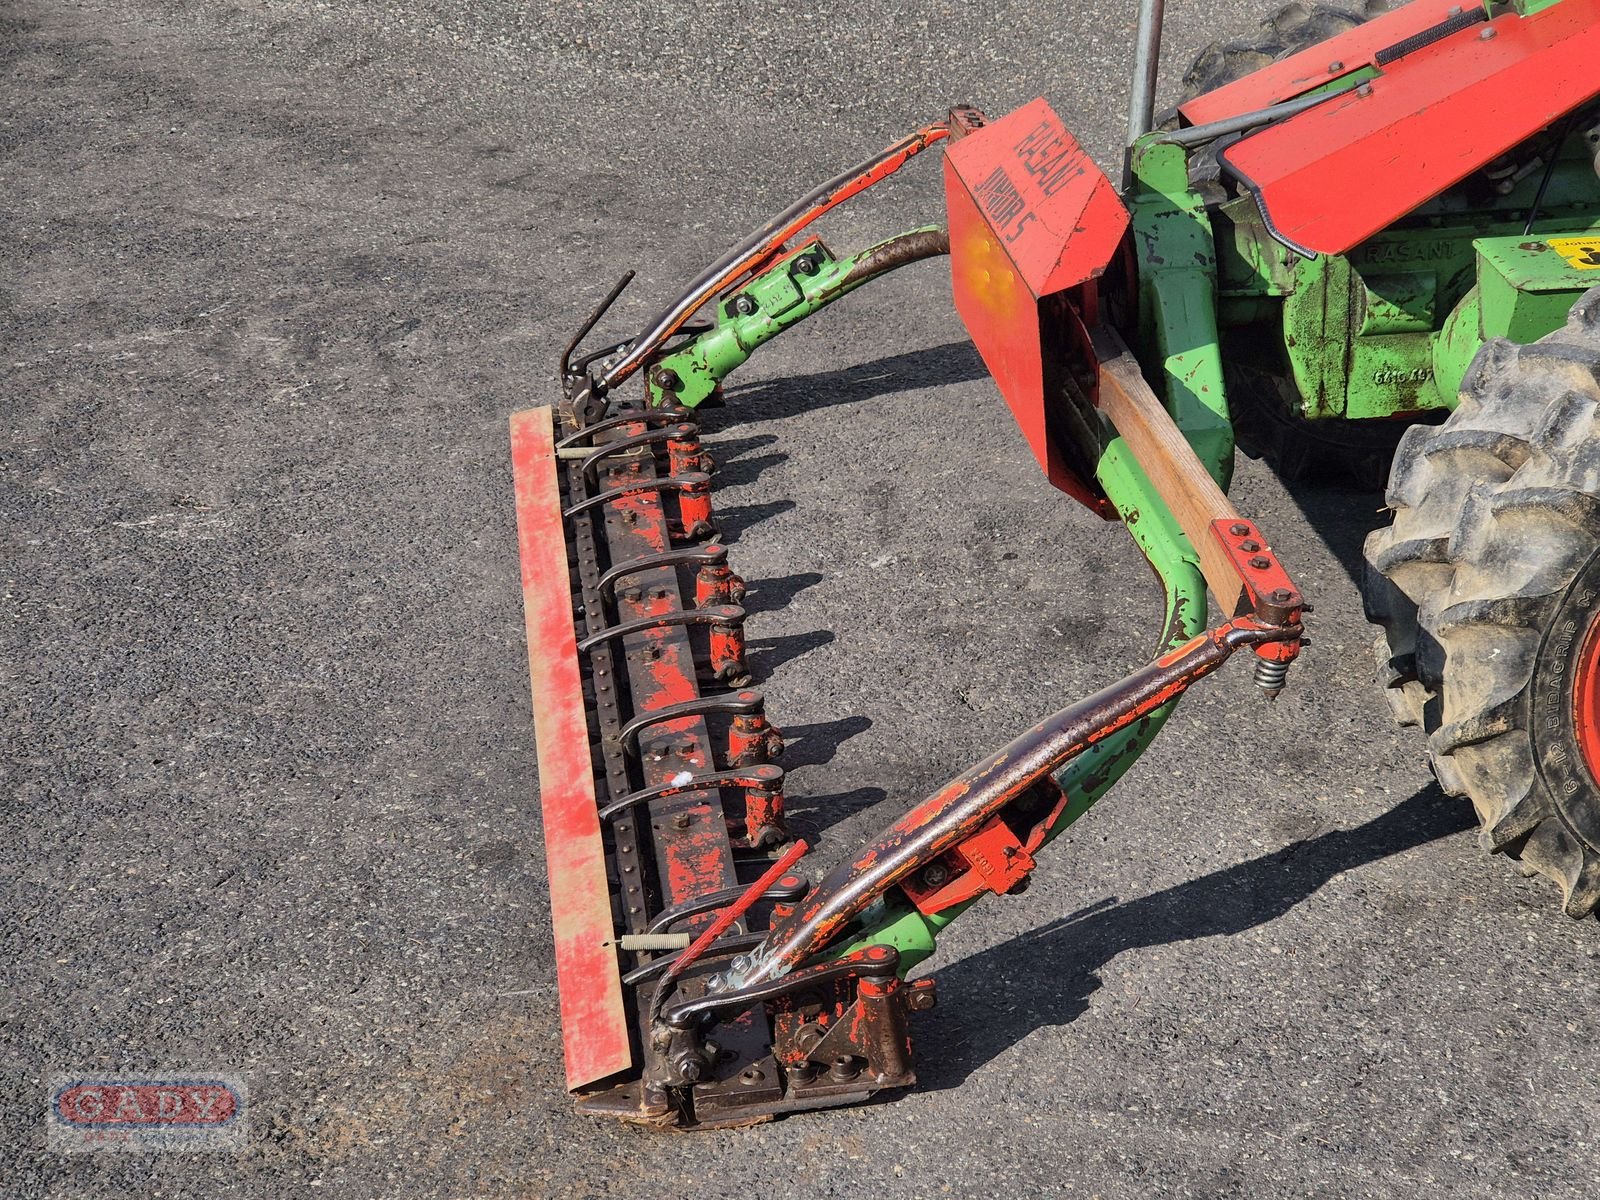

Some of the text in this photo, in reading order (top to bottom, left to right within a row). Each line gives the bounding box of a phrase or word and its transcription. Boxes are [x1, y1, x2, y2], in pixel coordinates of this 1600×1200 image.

[1013, 121, 1085, 196] RASANT
[973, 165, 1026, 231] JUNIOR
[1365, 240, 1453, 263] RASANT
